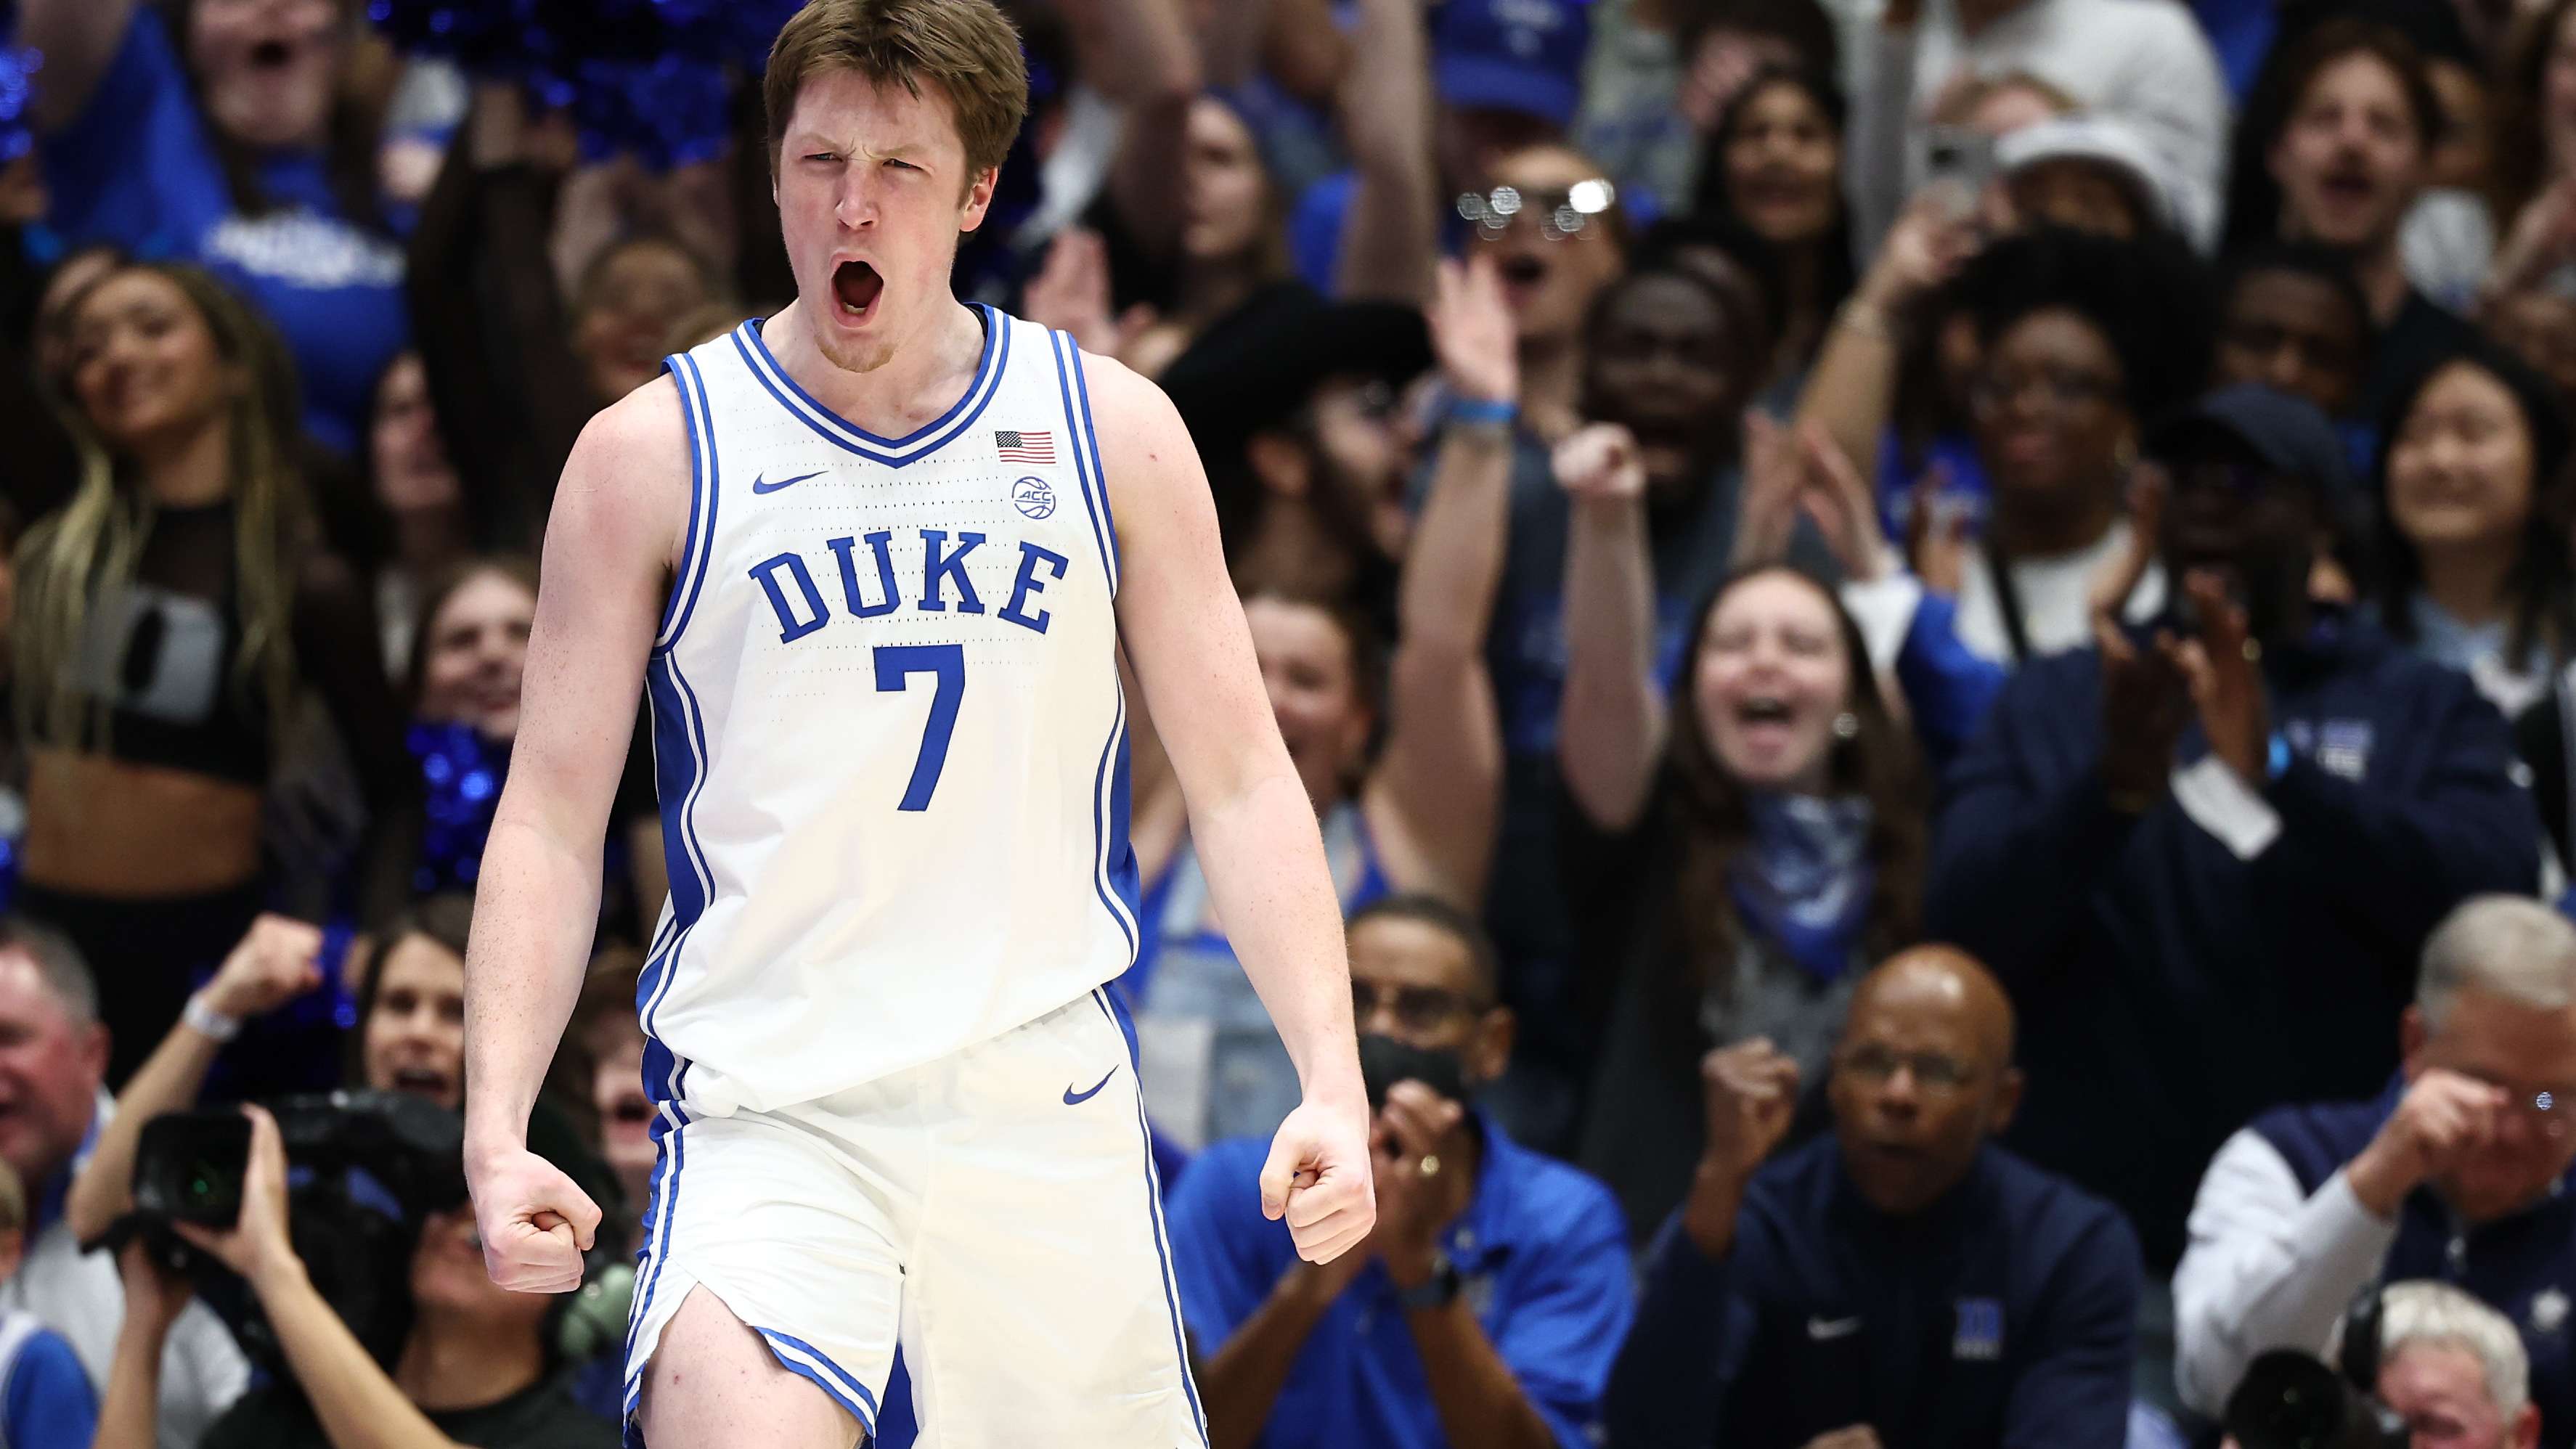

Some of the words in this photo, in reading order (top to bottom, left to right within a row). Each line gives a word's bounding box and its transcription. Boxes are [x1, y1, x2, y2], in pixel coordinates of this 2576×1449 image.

[1019, 491, 1052, 502] ACC
[748, 528, 1069, 645] DUKE
[872, 643, 966, 812] 7
